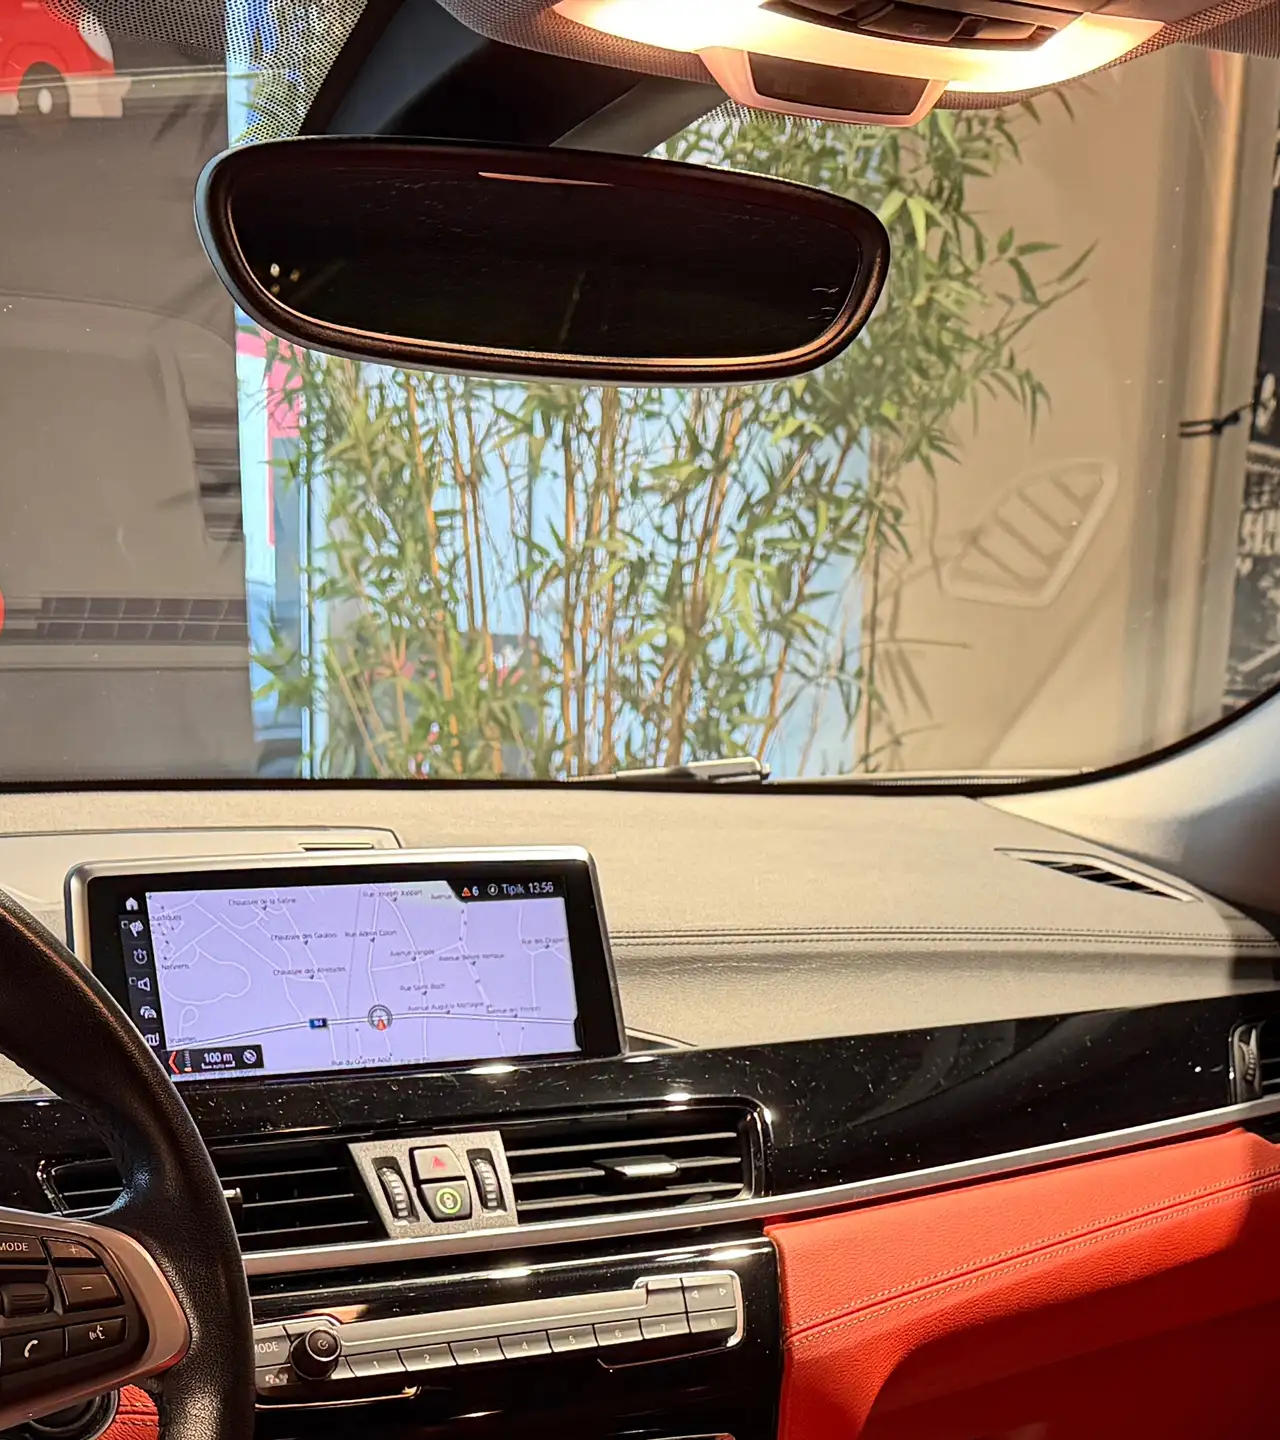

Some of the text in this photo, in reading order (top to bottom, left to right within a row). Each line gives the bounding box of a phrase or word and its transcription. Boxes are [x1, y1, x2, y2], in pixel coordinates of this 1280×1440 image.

[472, 886, 480, 896] 6
[501, 883, 524, 895] Tipik
[203, 1052, 234, 1063] 100 m
[710, 1317, 717, 1327] 8
[660, 1323, 667, 1333] 7
[614, 1329, 622, 1339] 6
[568, 1335, 576, 1344] 5
[521, 1341, 529, 1351] 4
[473, 1347, 480, 1357] 3
[423, 1354, 431, 1364] 2
[373, 1360, 380, 1370] 1
